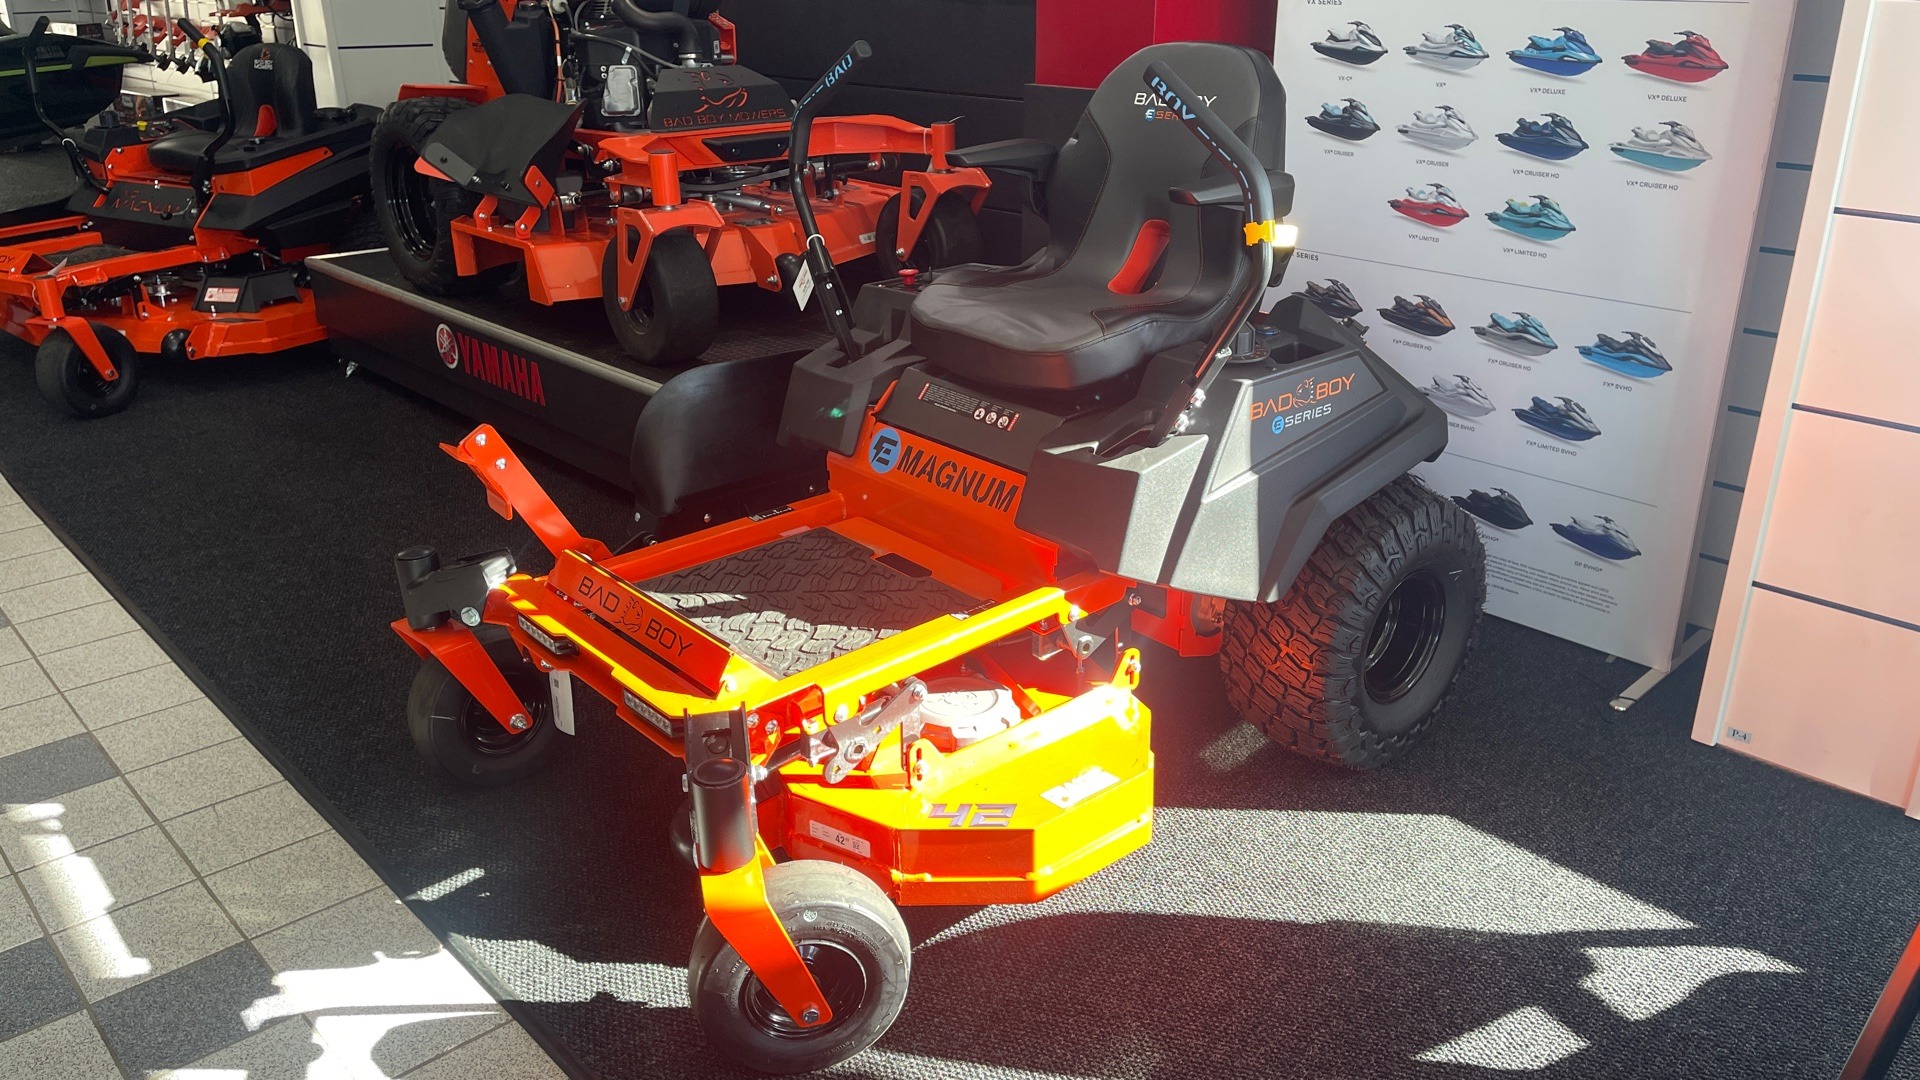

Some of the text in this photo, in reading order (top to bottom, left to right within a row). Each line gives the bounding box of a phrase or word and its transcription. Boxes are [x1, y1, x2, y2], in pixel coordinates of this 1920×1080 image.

[824, 54, 853, 87] BAD
[663, 108, 786, 127] BAD BOY MOWERS
[1524, 170, 1550, 178] CRUISER
[1639, 181, 1667, 190] CRUISER
[1419, 235, 1440, 243] LIMITED
[1296, 252, 1319, 261] SERIES
[1514, 249, 1538, 257] LIMITED
[1402, 340, 1424, 350] CRUISER
[457, 331, 546, 407] YAMAHA
[1498, 360, 1522, 370] CRUISER
[1250, 373, 1355, 421] BAD BOY
[1285, 403, 1332, 428] SERIES
[1537, 442, 1560, 453] LIMITED
[897, 445, 1020, 513] MAGNUM
[578, 575, 693, 657] BAD BOY
[928, 803, 1018, 828] 42
[835, 834, 845, 846] 42
